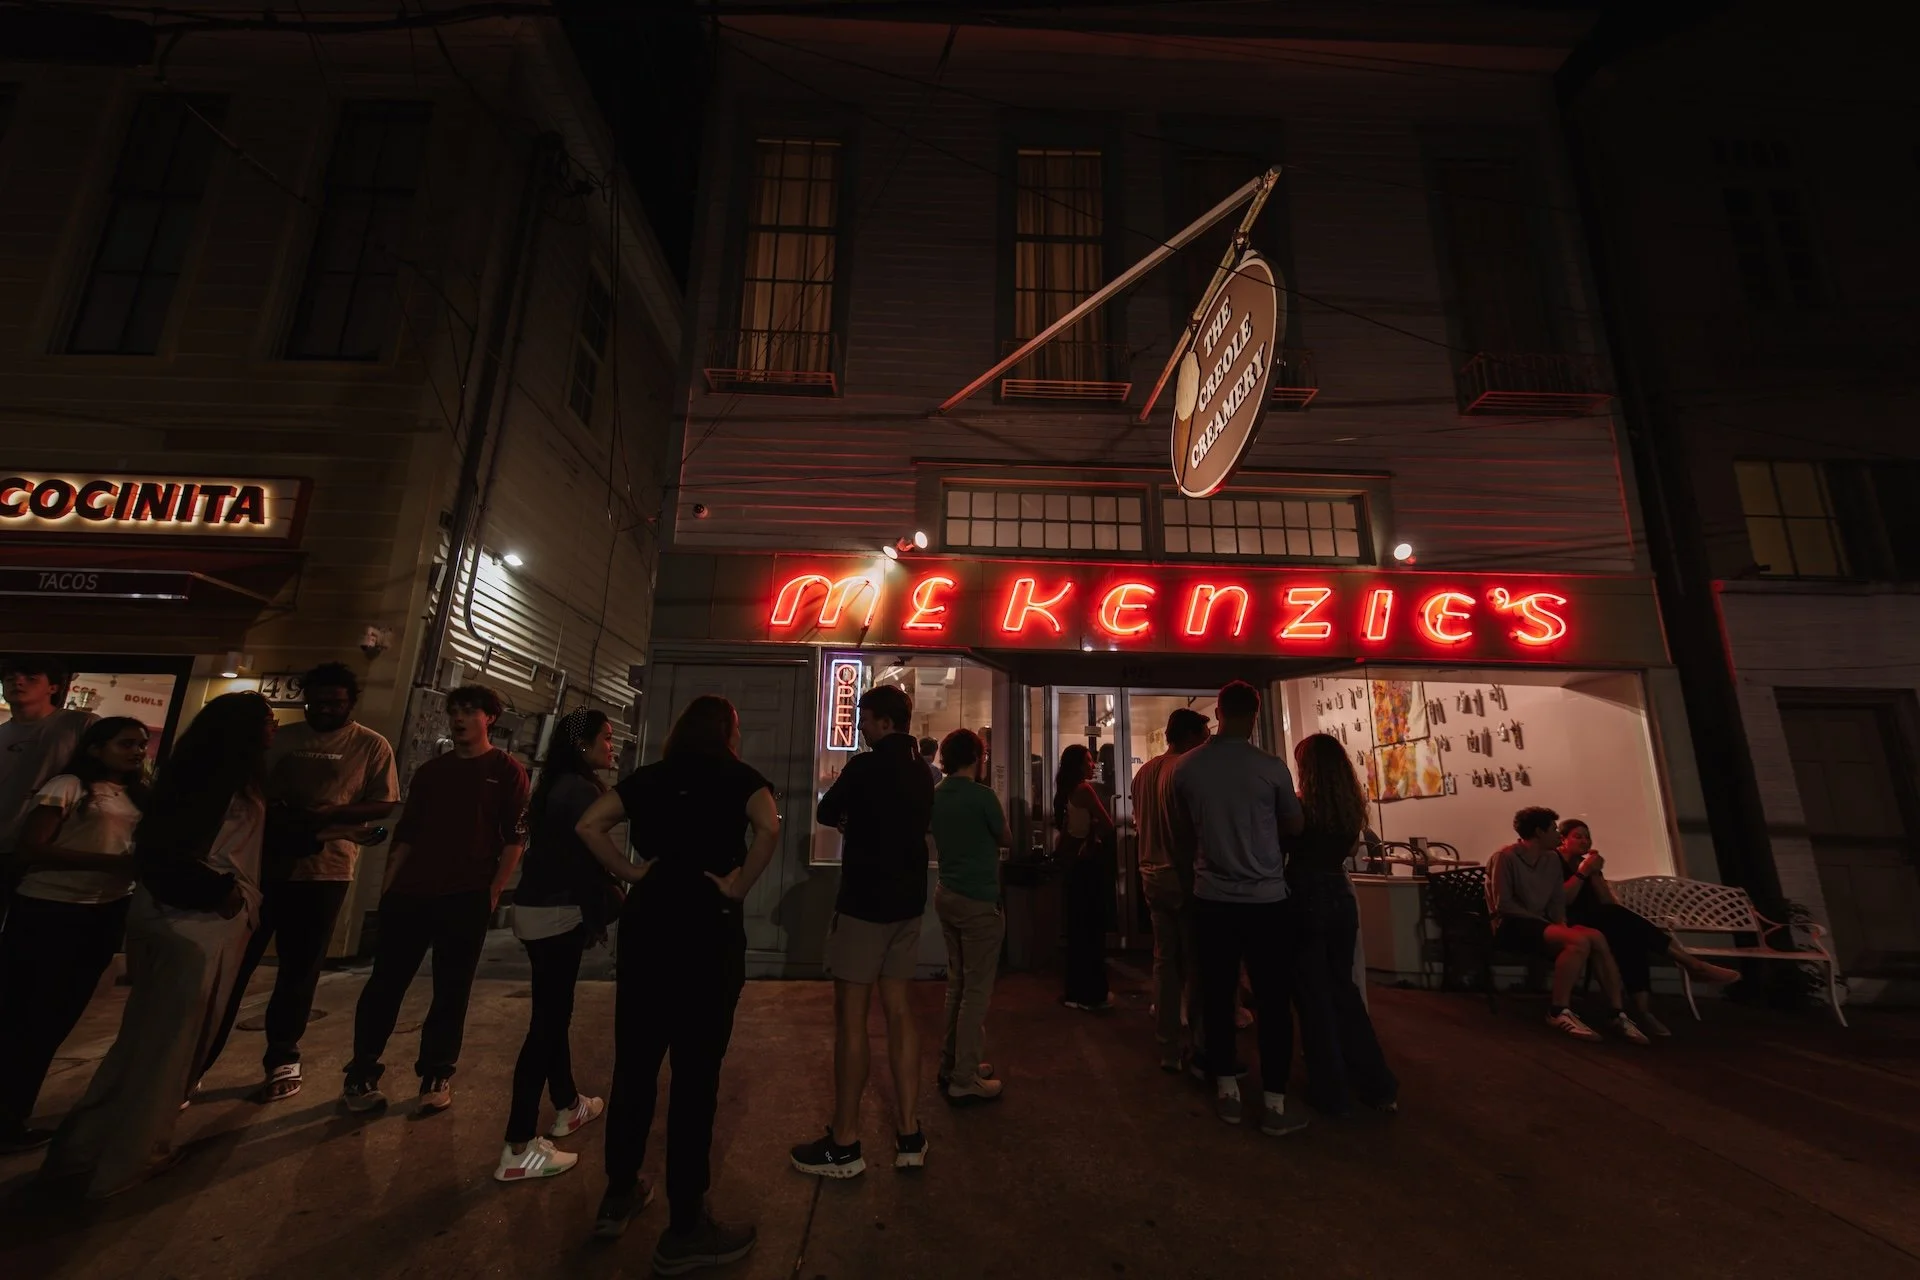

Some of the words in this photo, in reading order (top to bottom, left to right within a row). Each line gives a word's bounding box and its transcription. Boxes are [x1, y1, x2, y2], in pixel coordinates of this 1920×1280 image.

[1203, 296, 1231, 357] THE
[1198, 312, 1252, 412] CREOLE
[1191, 342, 1266, 469] CREAMERY
[0, 477, 265, 524] COCINITA
[37, 572, 99, 591] TACOS
[124, 694, 164, 707] BOWLS
[833, 664, 857, 746] OPEN
